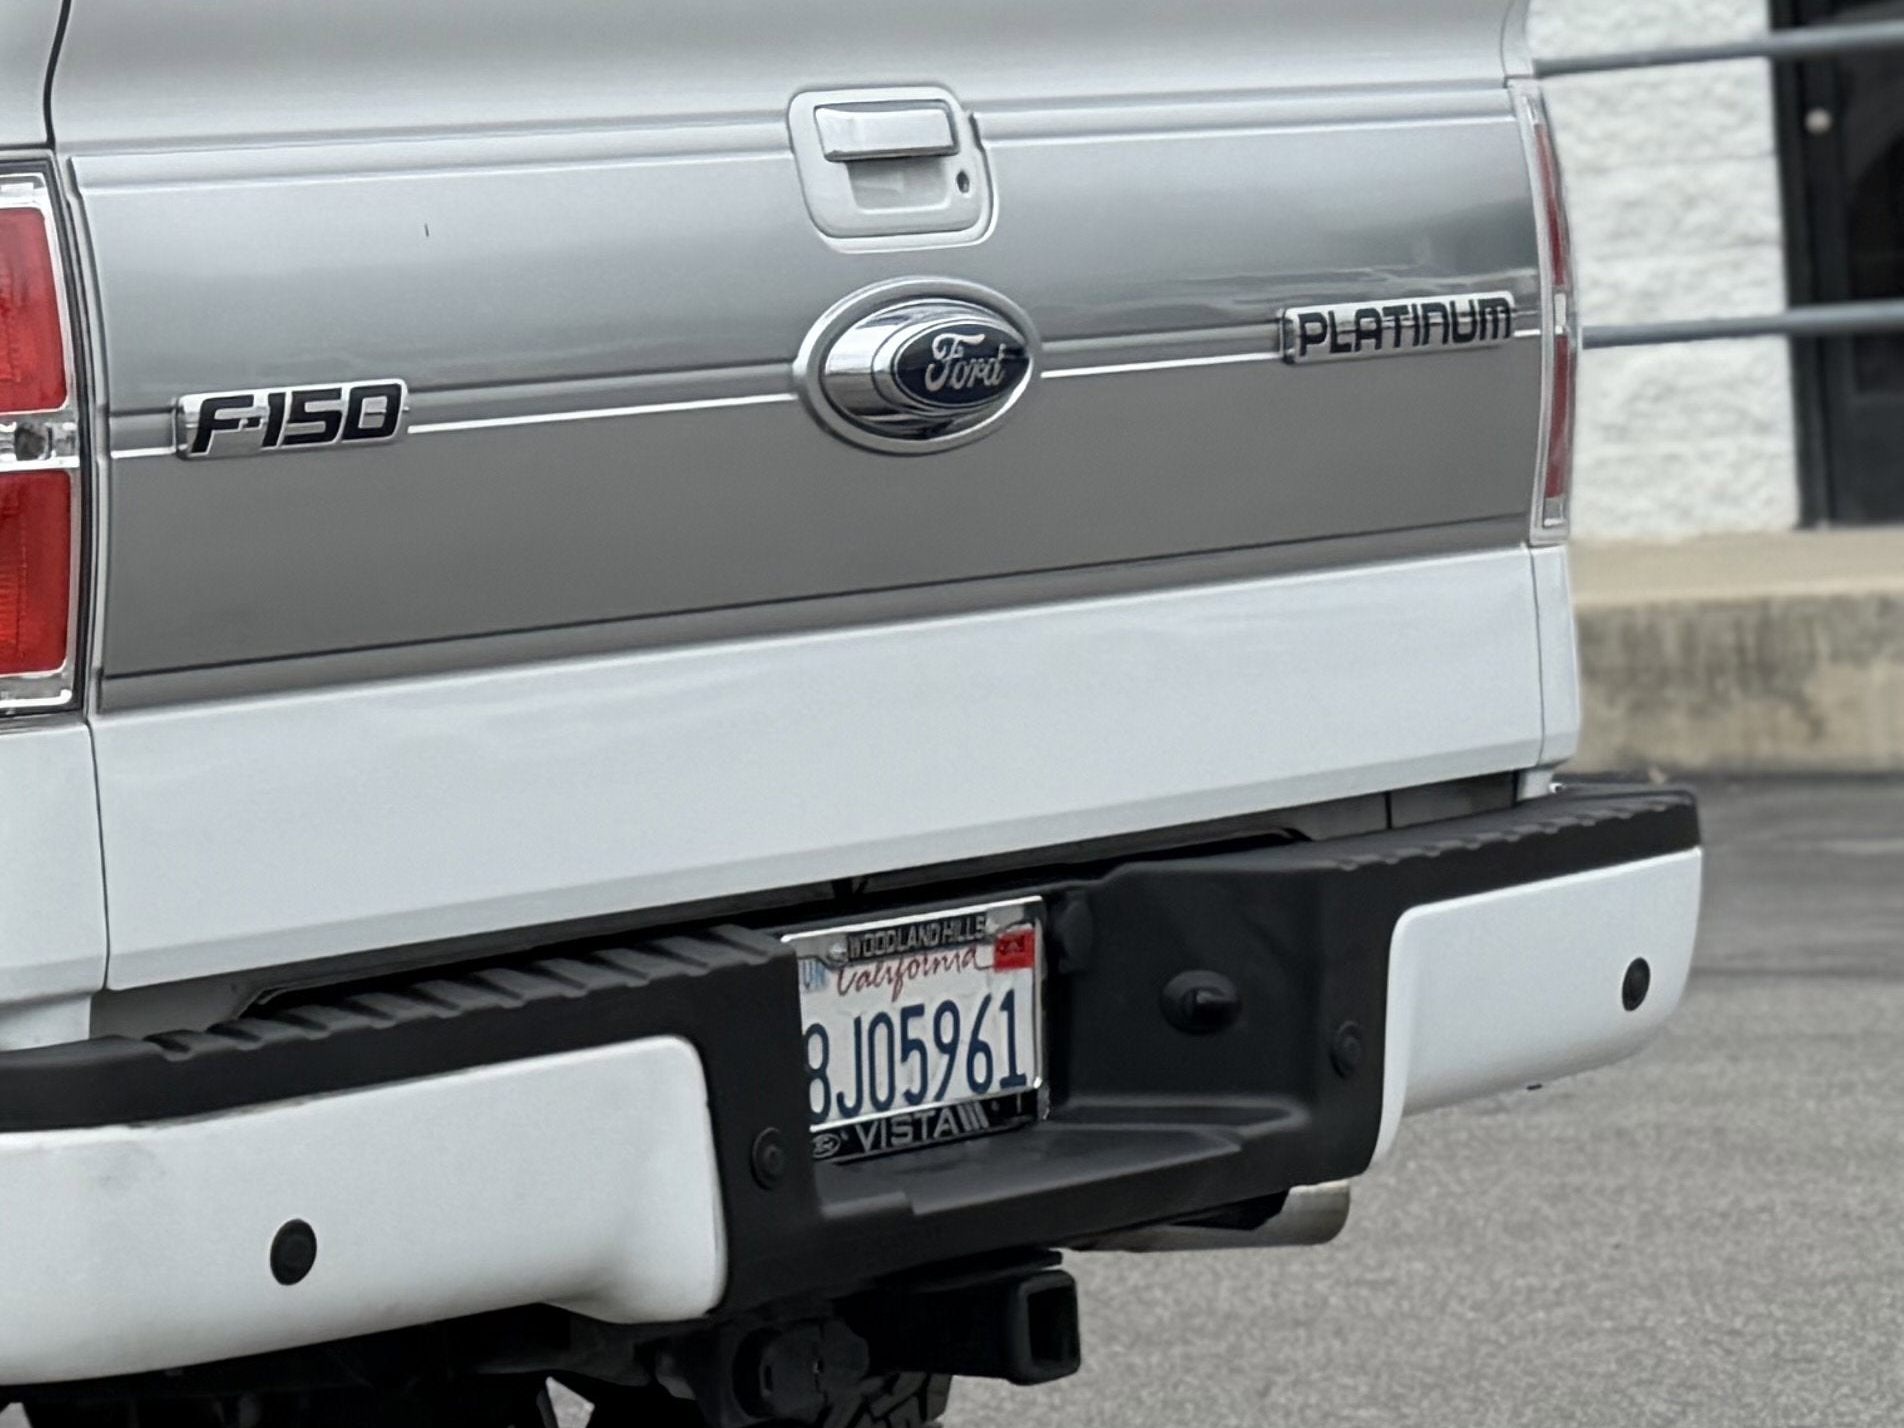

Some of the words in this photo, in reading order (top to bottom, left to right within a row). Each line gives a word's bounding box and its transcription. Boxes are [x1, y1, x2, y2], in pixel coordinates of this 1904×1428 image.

[1297, 296, 1513, 358] PLATINUM
[924, 331, 1007, 393] Ford
[191, 381, 404, 456] F-150
[848, 923, 940, 959] WOODLAND
[942, 915, 986, 943] HILLS
[835, 943, 980, 1003] California
[804, 988, 1027, 1126] 8J05961
[854, 1107, 958, 1154] VISTA
